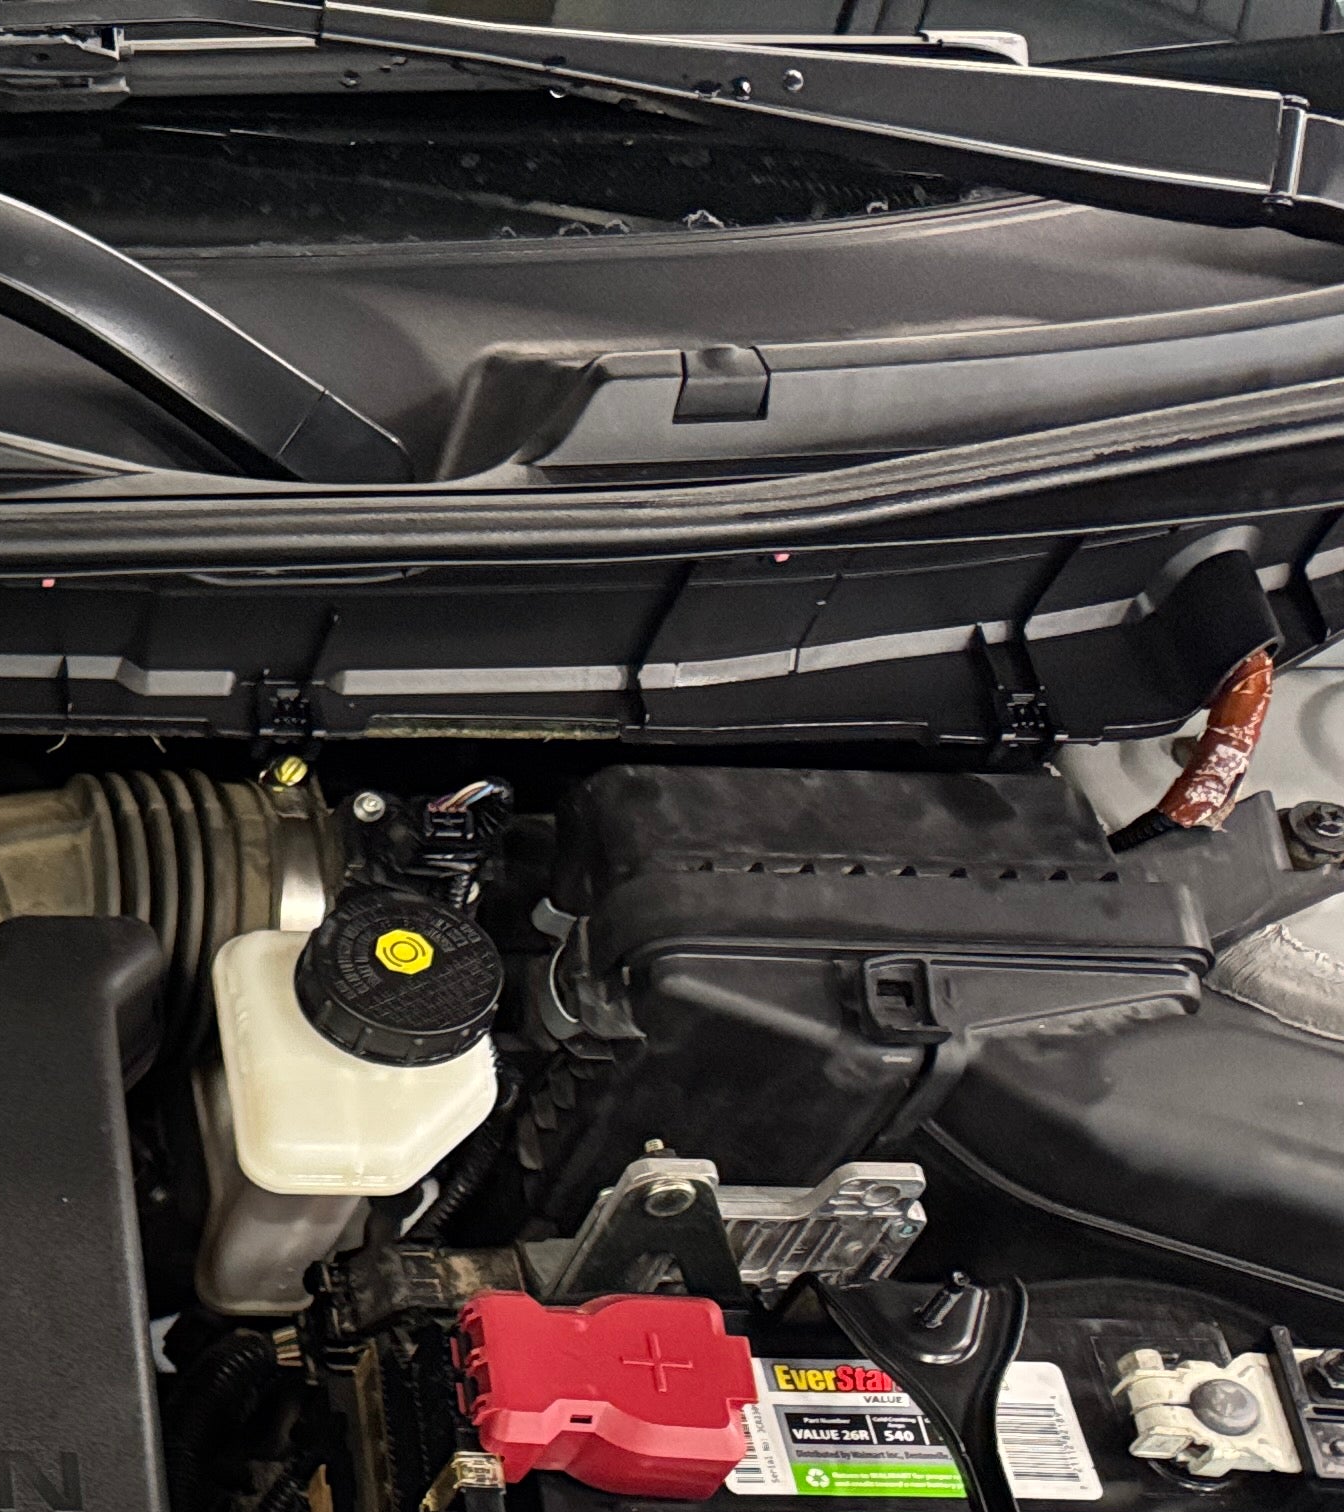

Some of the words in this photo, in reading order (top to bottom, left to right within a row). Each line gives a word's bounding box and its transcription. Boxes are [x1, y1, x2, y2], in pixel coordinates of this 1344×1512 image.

[772, 1363, 903, 1392] EverStar
[863, 1395, 903, 1404] VALUE
[792, 1428, 840, 1440] VALUE
[841, 1430, 870, 1441] 26R
[884, 1430, 914, 1442] 540
